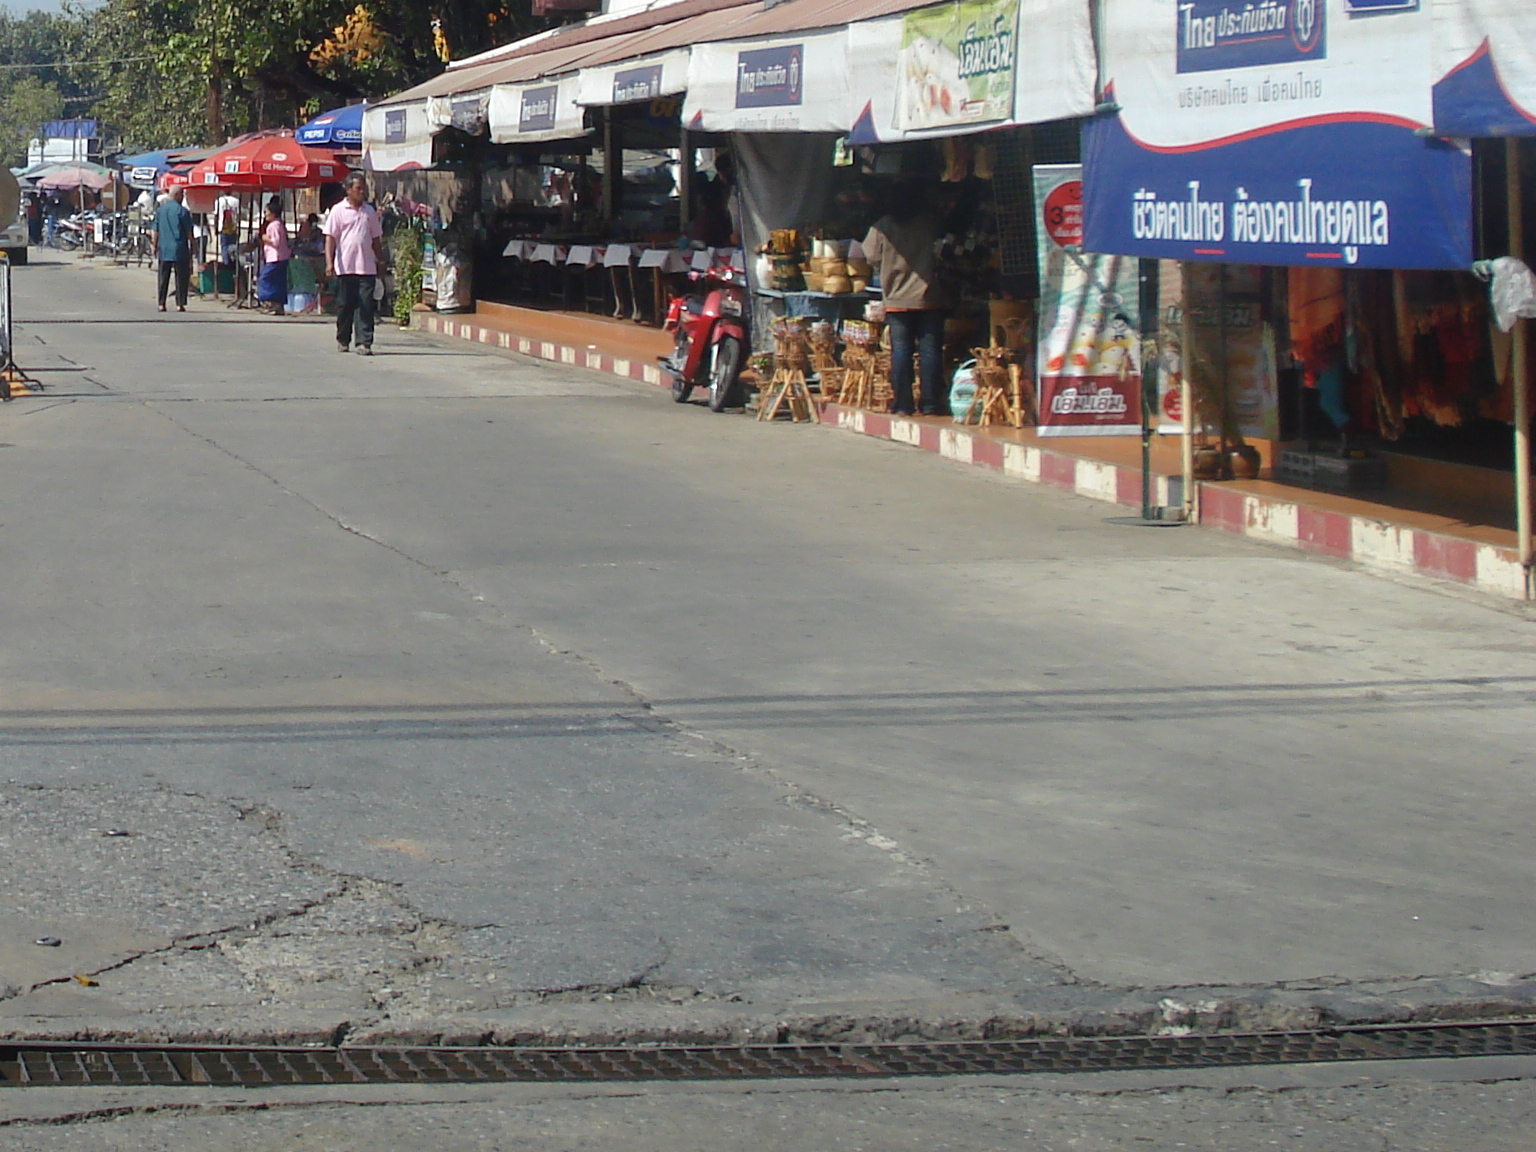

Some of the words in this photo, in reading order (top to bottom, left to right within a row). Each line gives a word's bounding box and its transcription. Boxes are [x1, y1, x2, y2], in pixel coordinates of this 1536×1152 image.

[1132, 180, 1225, 242] ชีวิตคนไทย
[1231, 178, 1389, 264] ต้องคนไทยดูแล
